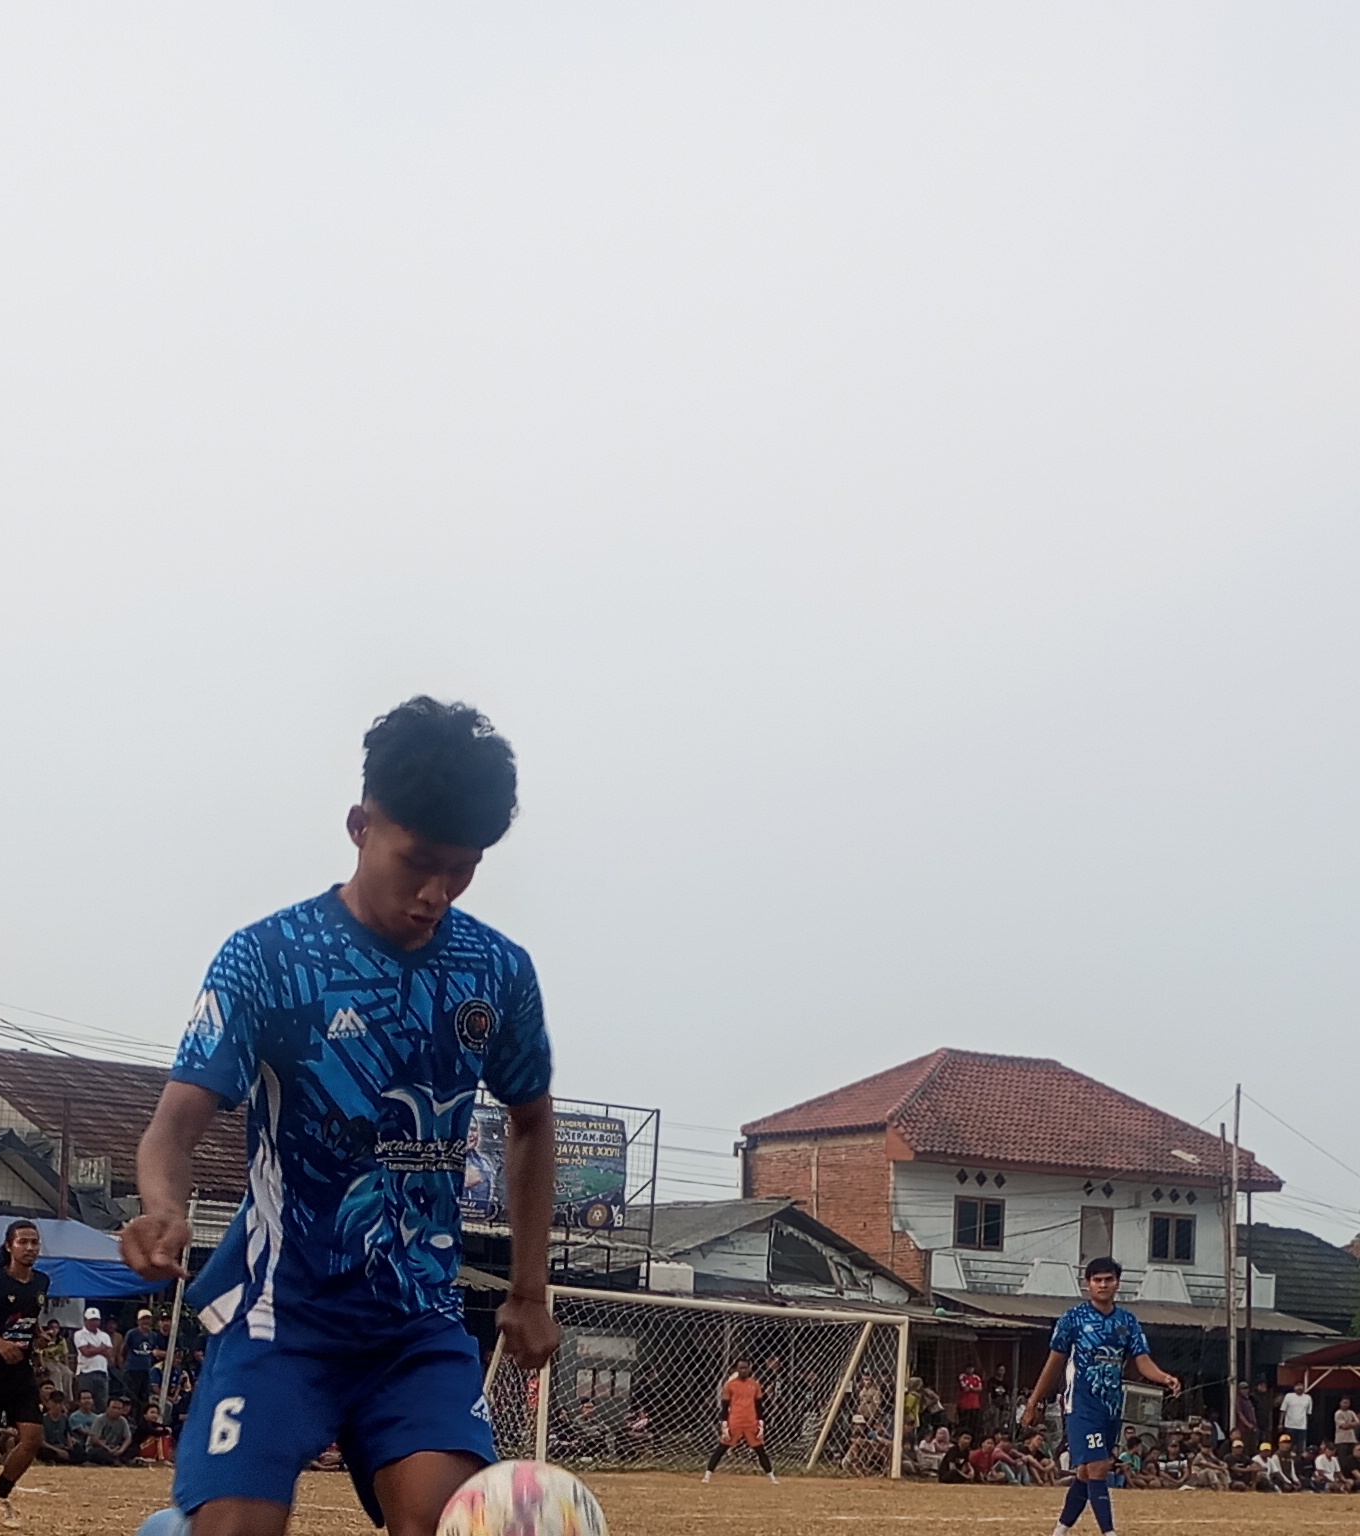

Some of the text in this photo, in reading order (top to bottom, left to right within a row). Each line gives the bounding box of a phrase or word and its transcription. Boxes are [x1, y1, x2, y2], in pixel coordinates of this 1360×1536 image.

[327, 1030, 367, 1040] MOST
[207, 1396, 246, 1454] 6
[1085, 1432, 1104, 1449] 32
